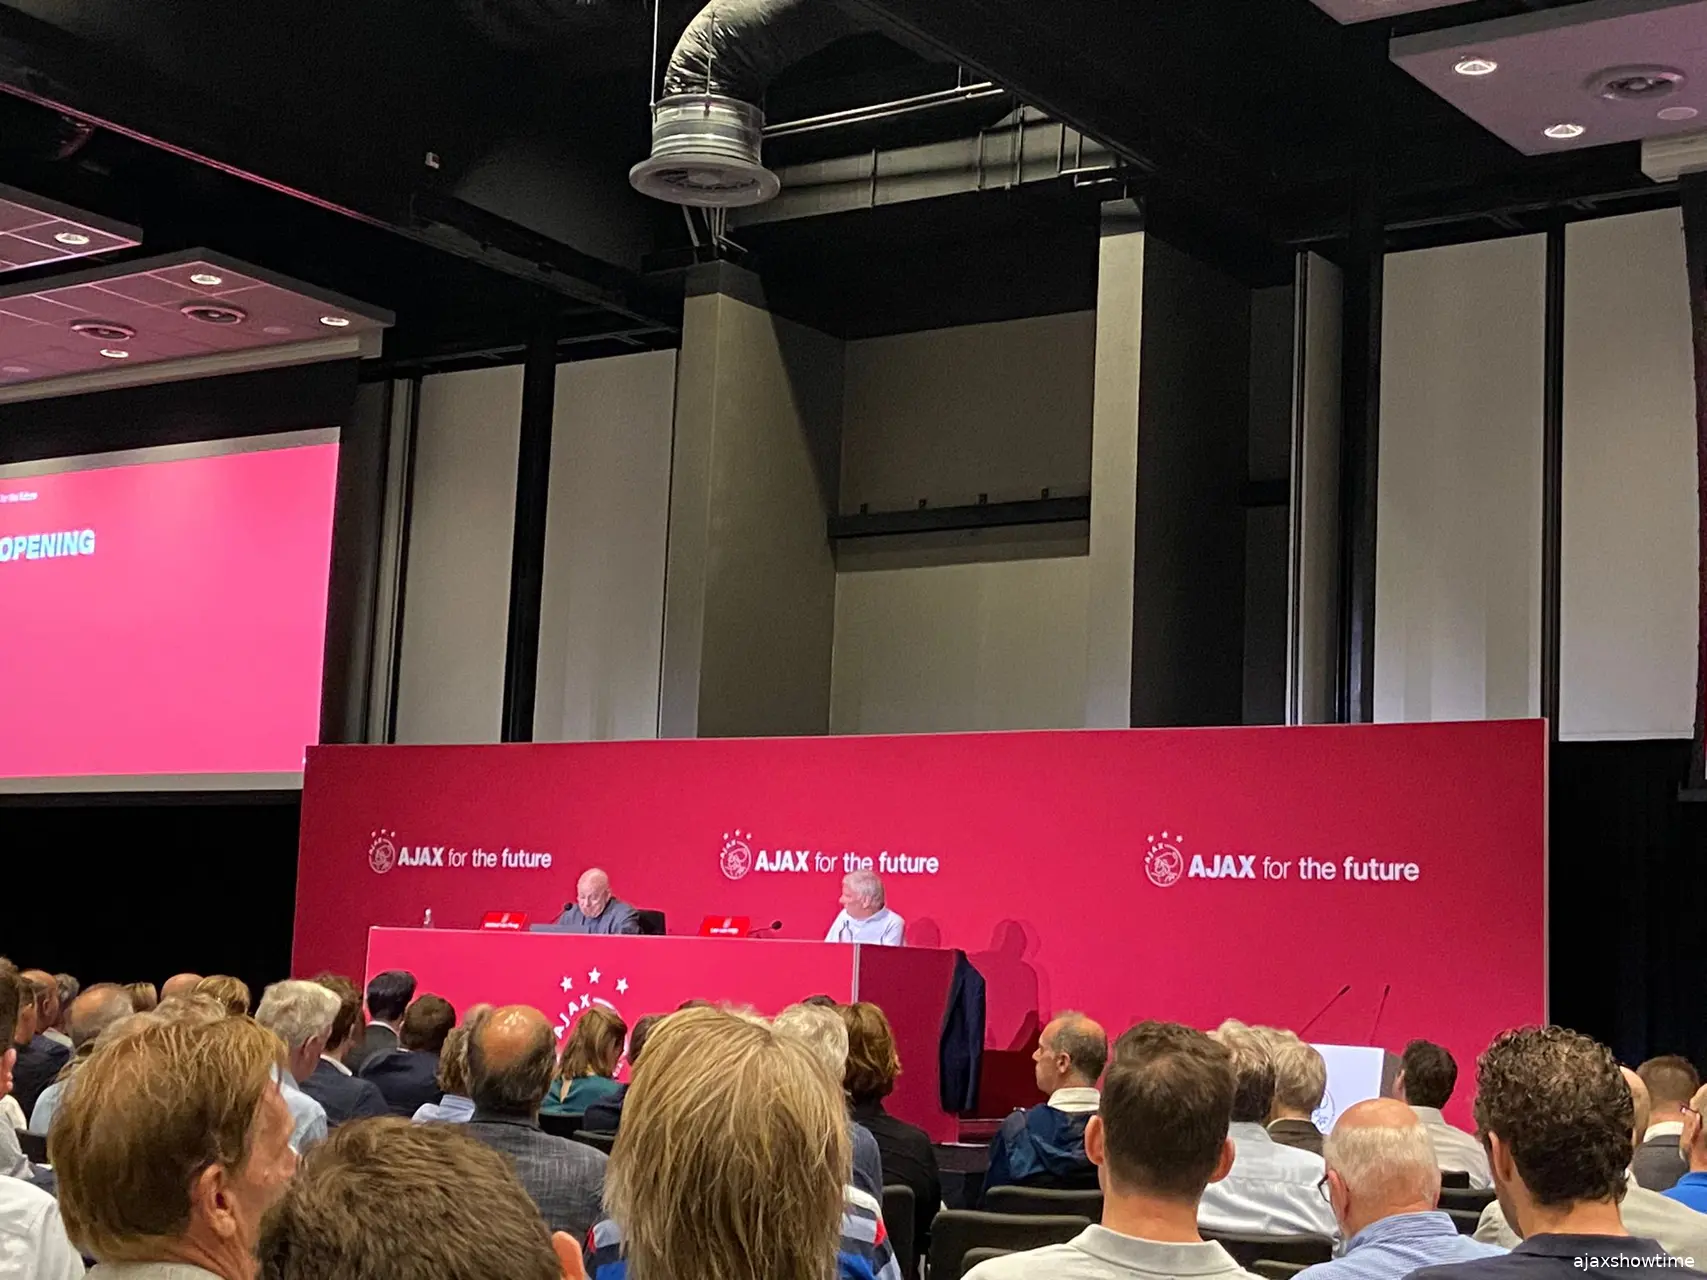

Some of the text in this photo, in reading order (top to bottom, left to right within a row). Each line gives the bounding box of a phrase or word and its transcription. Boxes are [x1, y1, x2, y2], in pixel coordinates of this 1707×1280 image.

[0, 529, 95, 562] OPENING
[398, 846, 553, 868] AJAX for the future
[754, 850, 940, 874] AJAX for the future
[1187, 854, 1420, 881] AJAX for the future
[553, 993, 591, 1039] AJAX
